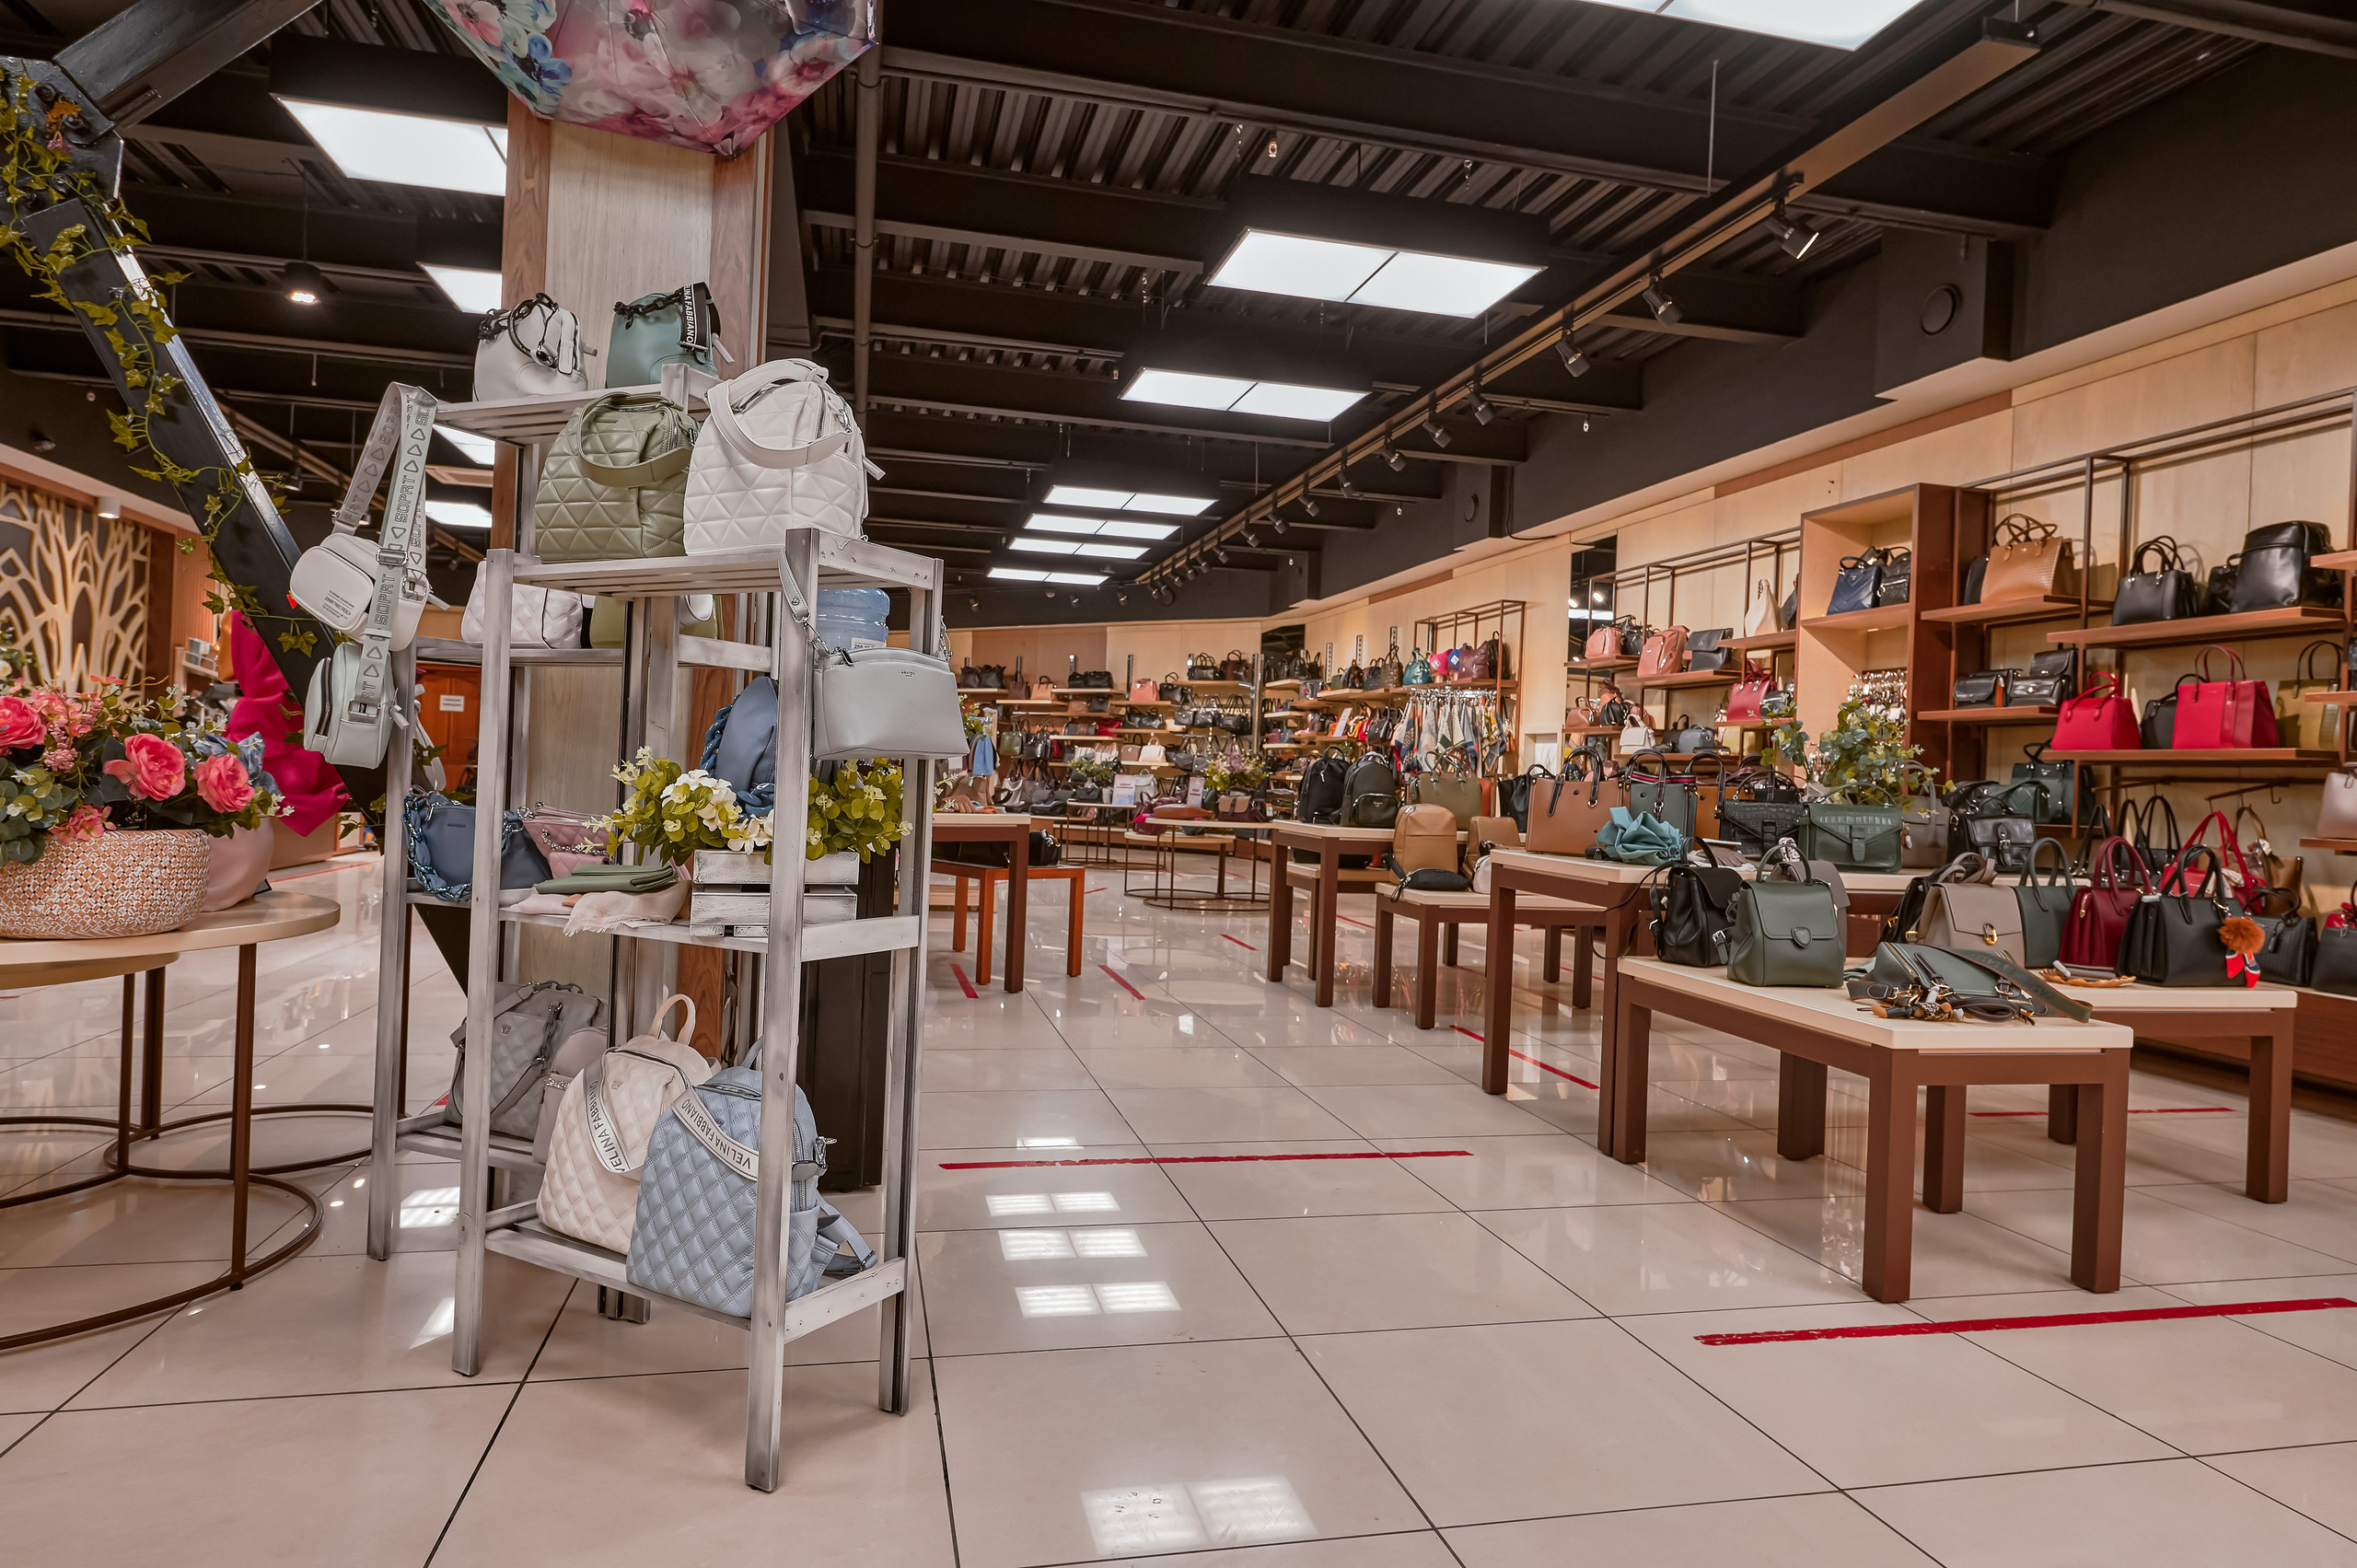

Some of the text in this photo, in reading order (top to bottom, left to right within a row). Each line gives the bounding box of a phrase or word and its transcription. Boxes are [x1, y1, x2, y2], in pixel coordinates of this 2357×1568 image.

[684, 300, 695, 343] FABBIANO
[394, 474, 416, 524] SOPRT
[374, 574, 396, 625] SOPRT
[589, 1079, 604, 1131] FABBIANO
[681, 1098, 751, 1170] VELINA FABBIANO
